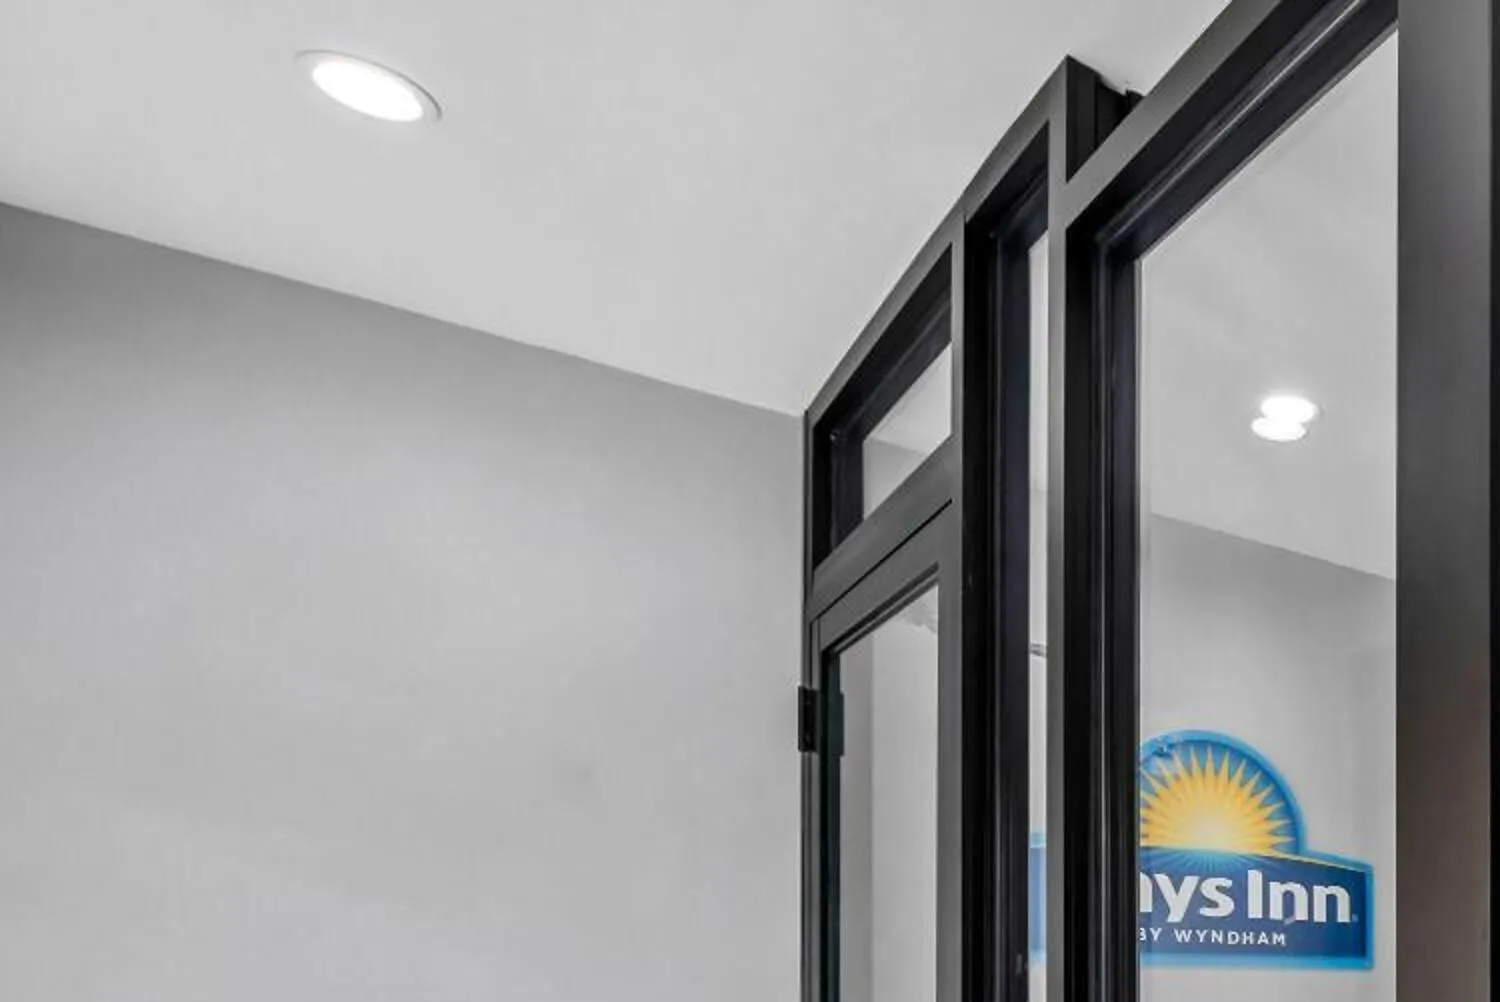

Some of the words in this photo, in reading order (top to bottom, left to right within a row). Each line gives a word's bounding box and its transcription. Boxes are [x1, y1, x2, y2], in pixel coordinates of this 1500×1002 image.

[1139, 871, 1235, 923] ys
[1247, 869, 1351, 923] Inn
[1174, 928, 1286, 946] WYNDHAM
